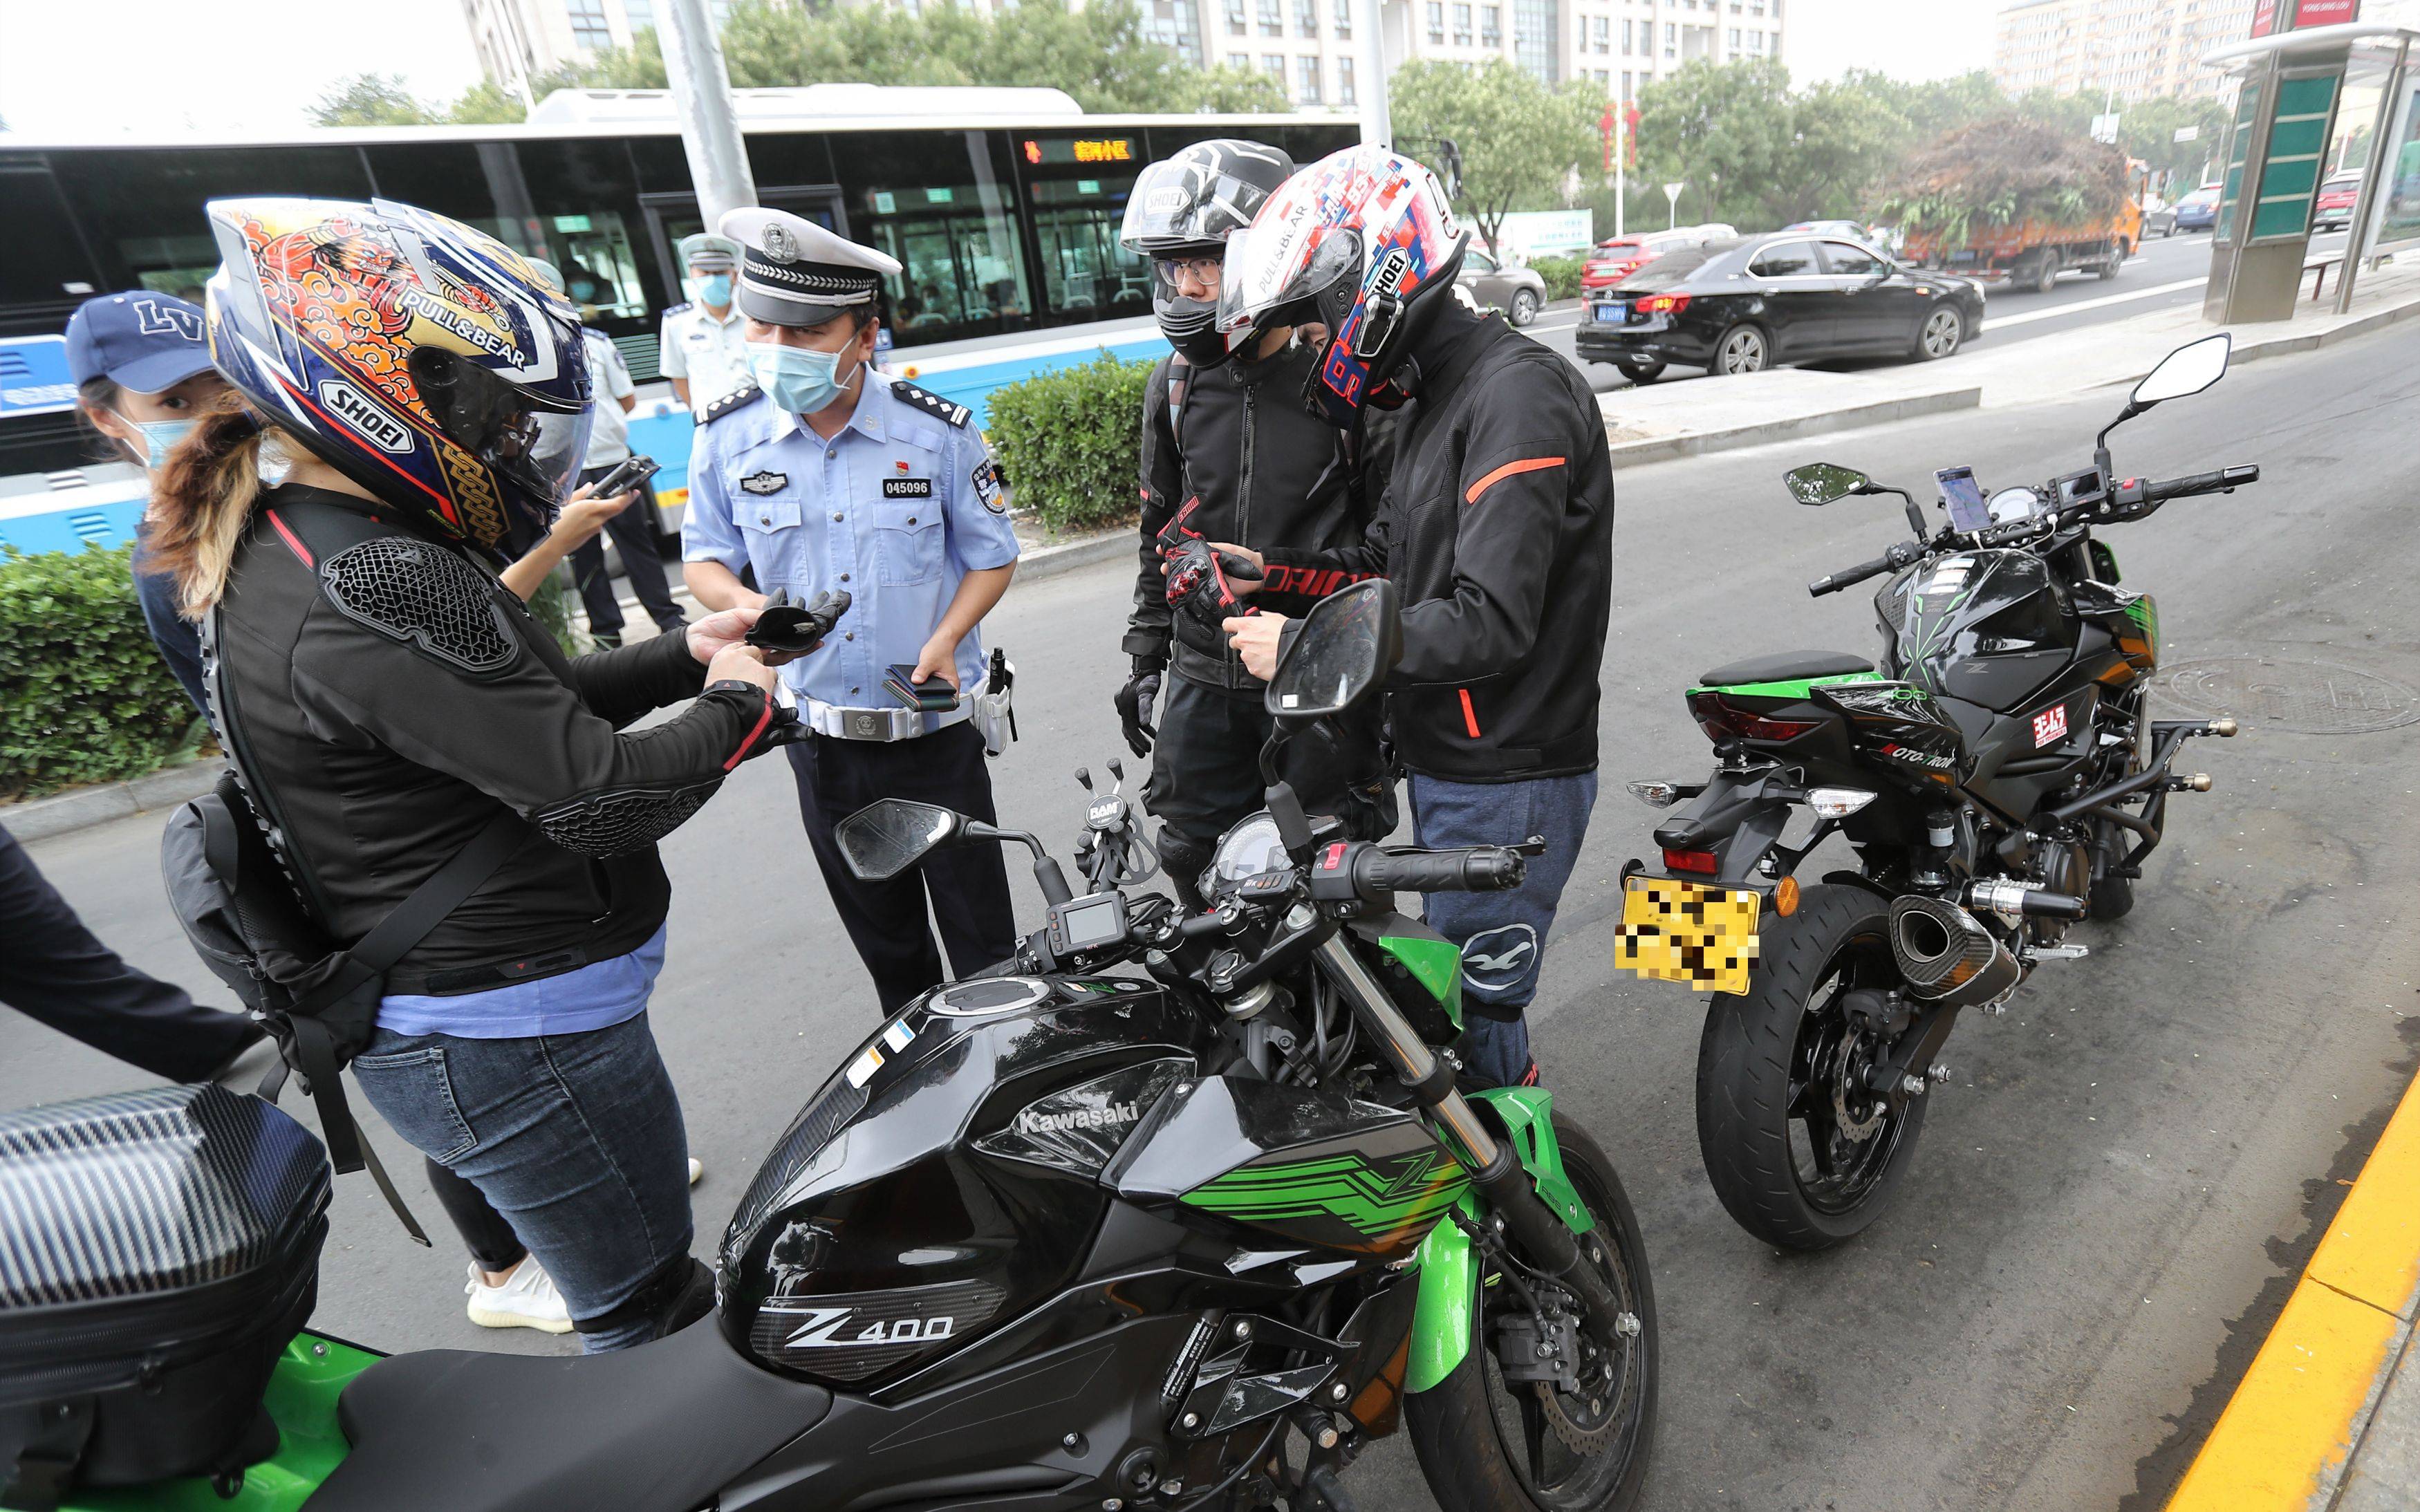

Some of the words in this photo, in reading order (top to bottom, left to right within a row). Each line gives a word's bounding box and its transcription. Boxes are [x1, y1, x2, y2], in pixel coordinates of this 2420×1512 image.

[1149, 193, 1182, 208] SHOEI
[1259, 206, 1308, 294] PULL&BEAR
[1371, 254, 1405, 293] HOEI
[133, 299, 204, 341] LV
[401, 288, 525, 371] PULL&BEAR
[330, 389, 404, 447] SHOEI
[886, 483, 927, 494] 045096
[1881, 743, 1956, 768] MOTO-TRON
[1018, 1101, 1139, 1135] Kawasaki
